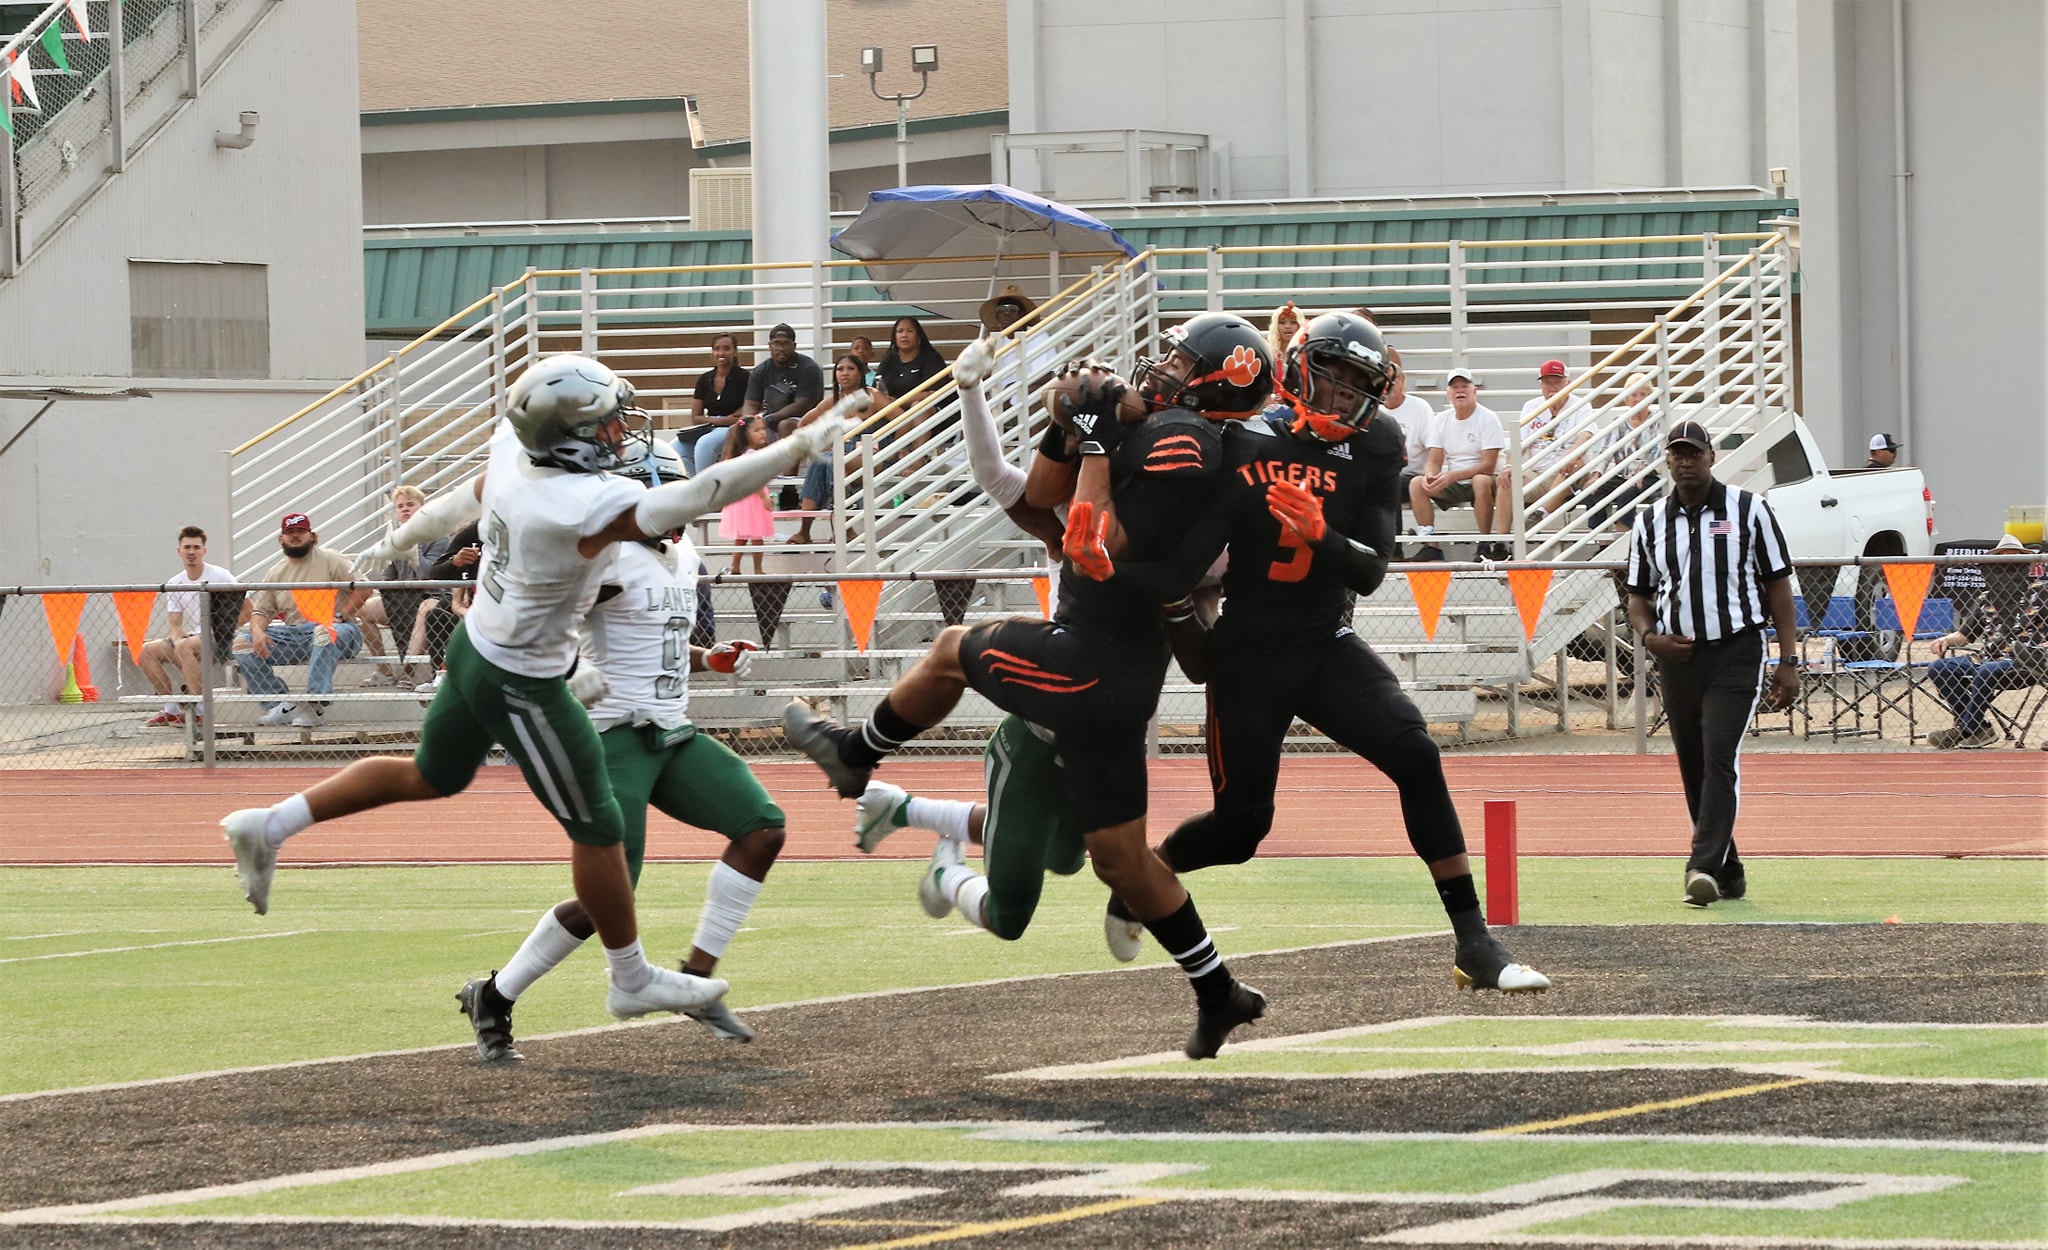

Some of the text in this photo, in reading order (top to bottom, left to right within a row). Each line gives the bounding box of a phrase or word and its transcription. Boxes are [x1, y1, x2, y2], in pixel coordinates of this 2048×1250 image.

[1072, 415, 1093, 435] adidas
[1327, 449, 1353, 461] adidas
[1236, 461, 1338, 493] TIGERS
[482, 509, 510, 604] 2
[655, 616, 691, 700] 9
